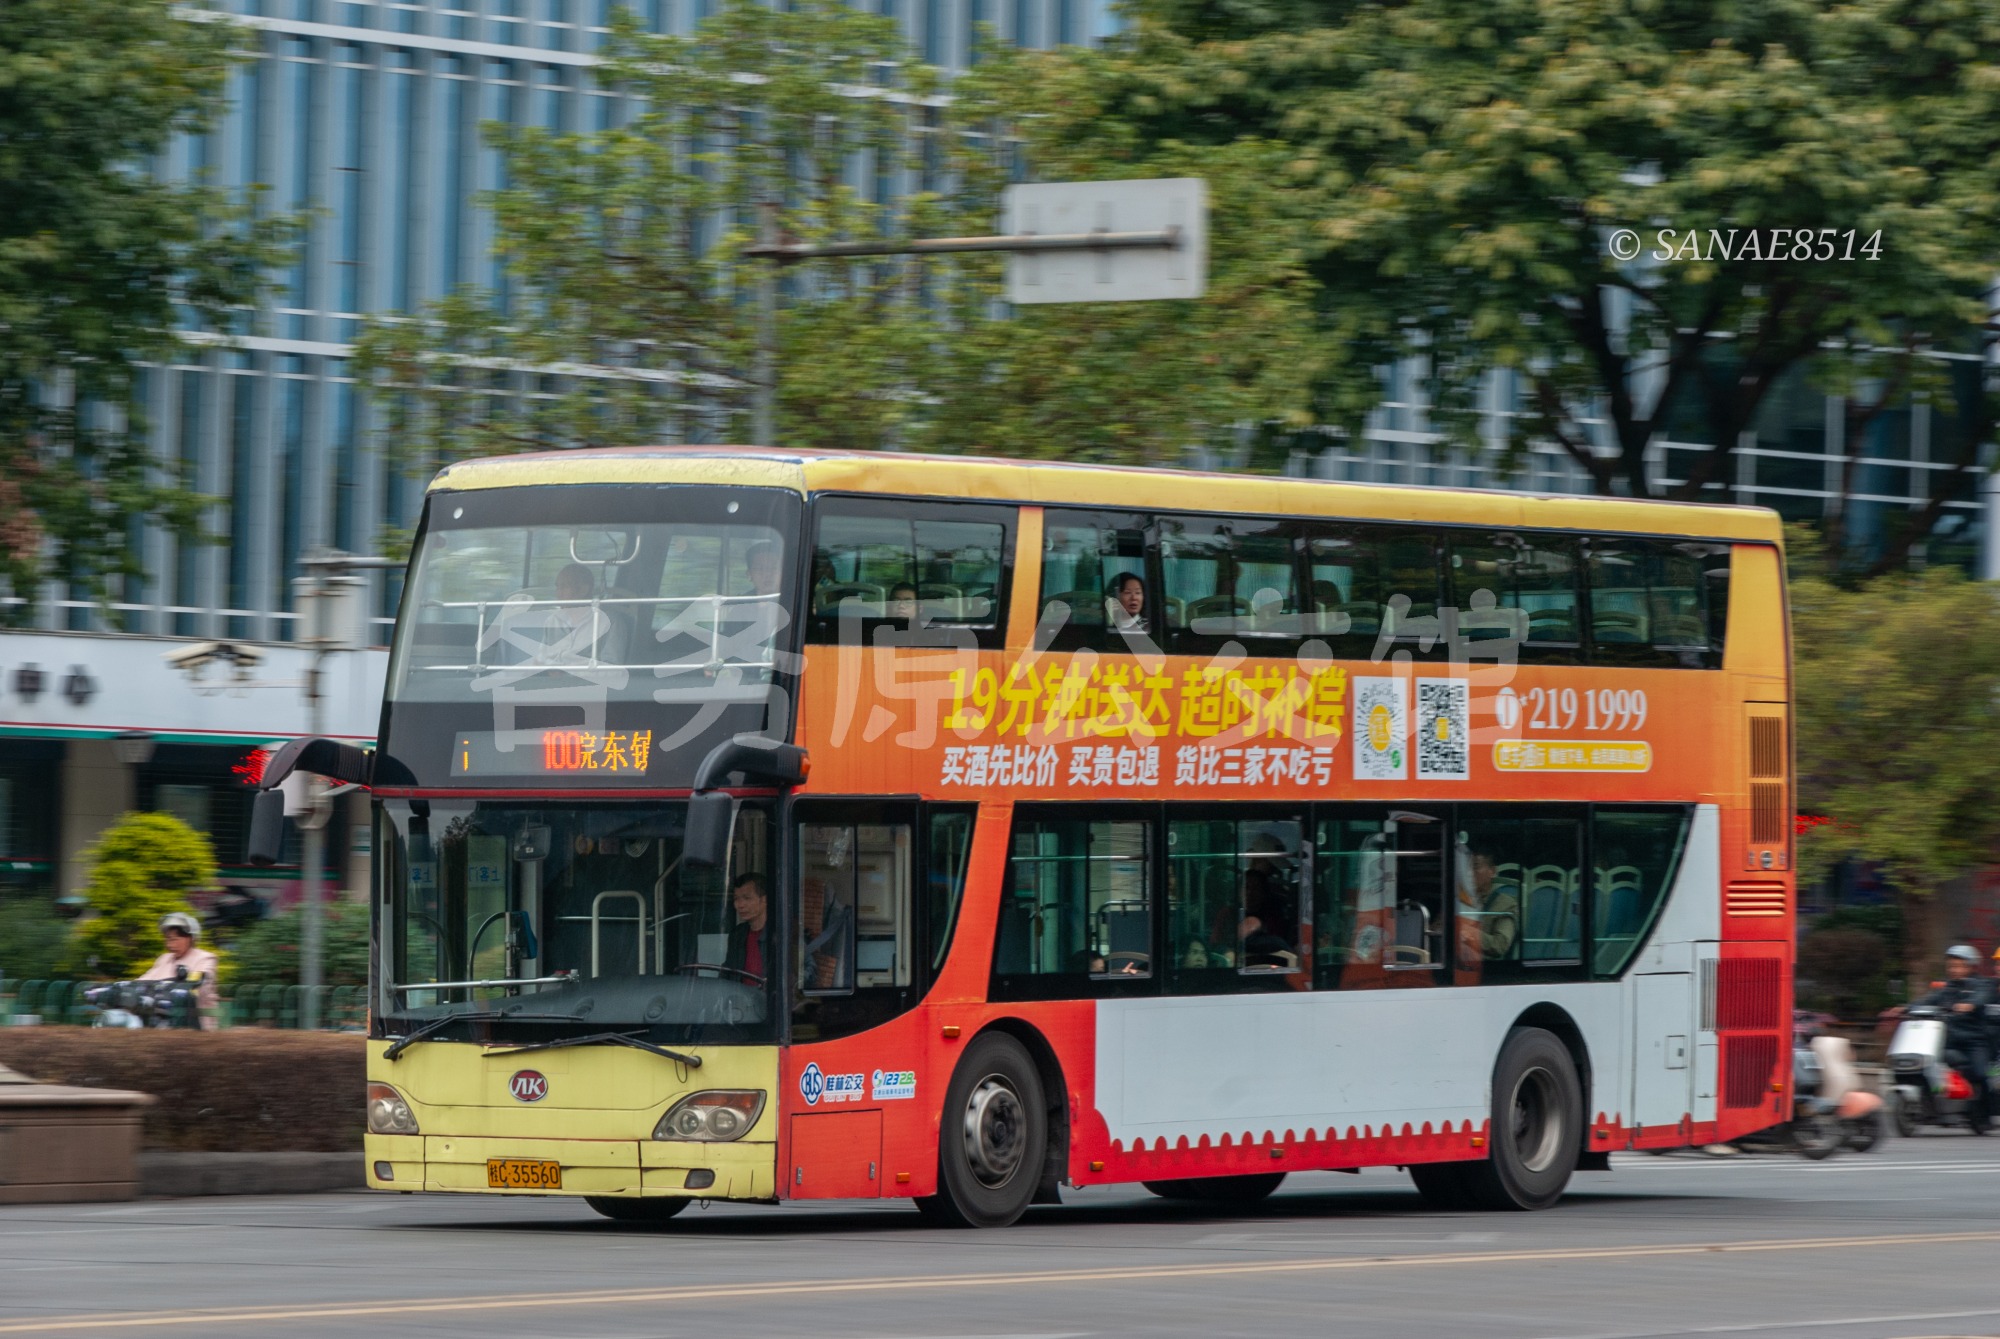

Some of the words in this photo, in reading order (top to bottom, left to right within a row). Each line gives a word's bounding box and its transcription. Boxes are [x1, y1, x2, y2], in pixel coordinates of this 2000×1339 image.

[943, 661, 1174, 738] 19分钟送达
[1176, 663, 1347, 739] 超时补偿
[1584, 688, 1648, 731] 1999
[544, 731, 580, 769] 100
[941, 744, 1060, 786] 买酒先比价
[1068, 745, 1160, 786] 买贵包退
[1174, 745, 1334, 786] 货比三家不吃亏
[825, 1075, 863, 1091] 桂林公交
